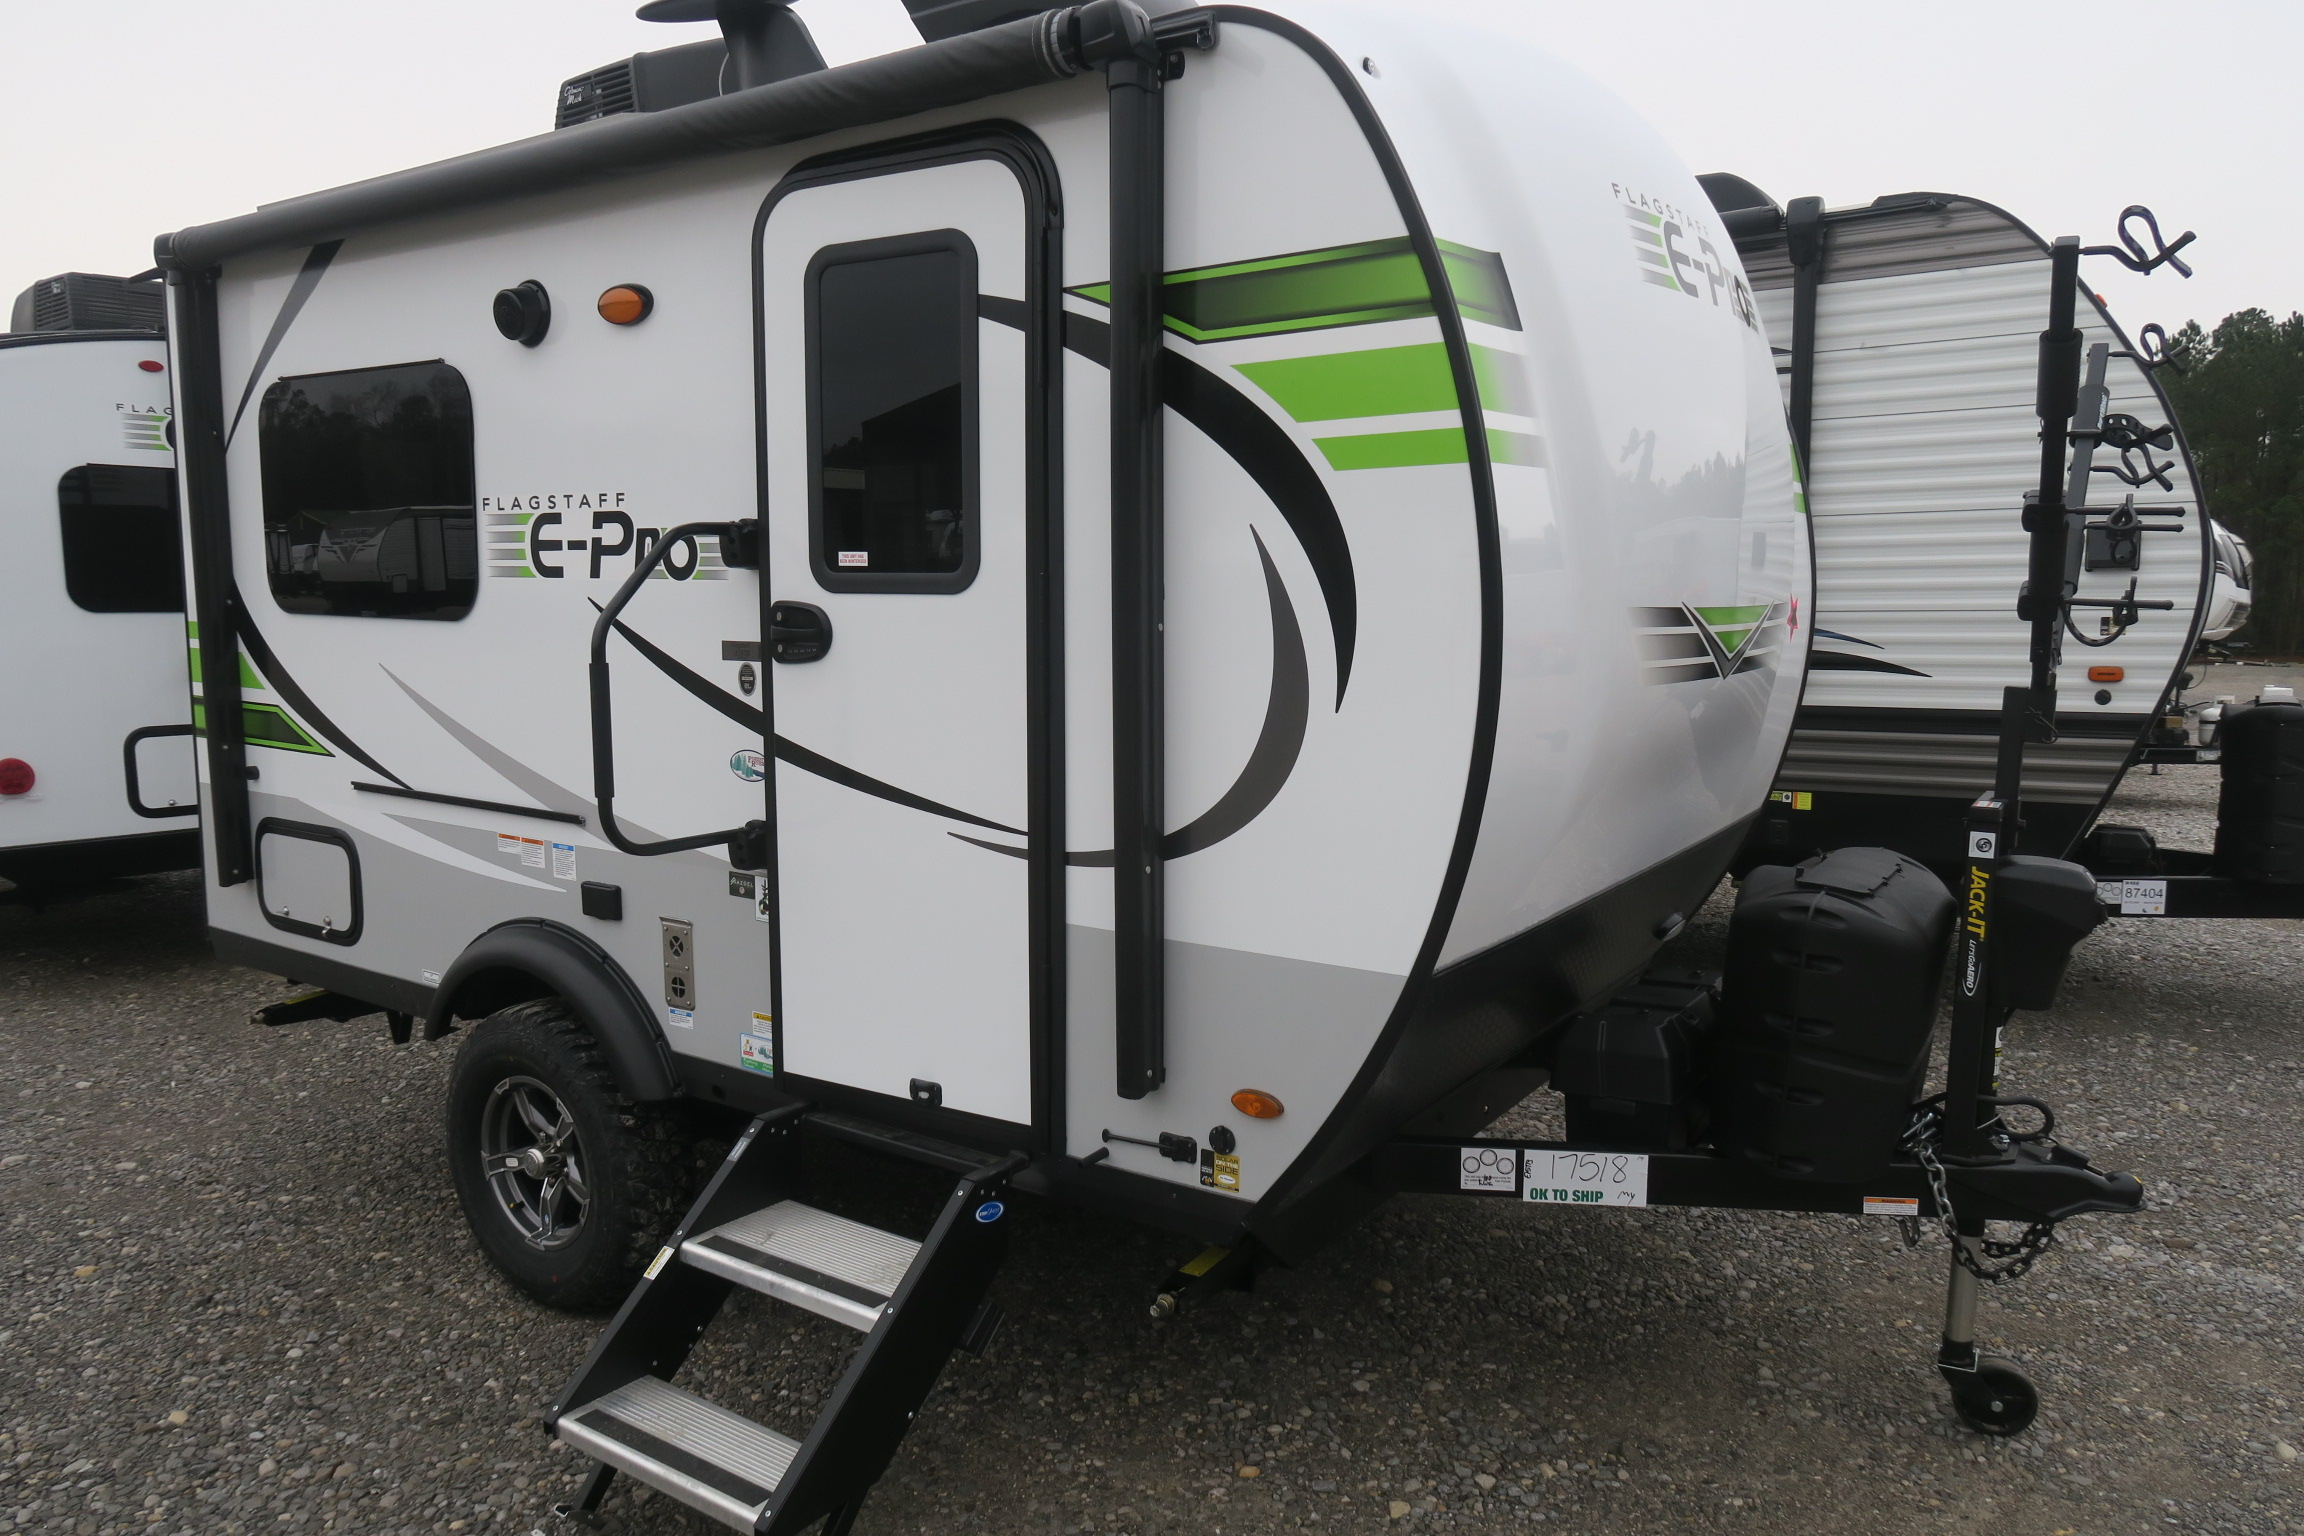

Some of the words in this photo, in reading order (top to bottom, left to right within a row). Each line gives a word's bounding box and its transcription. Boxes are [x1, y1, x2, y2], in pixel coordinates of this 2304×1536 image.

[1610, 182, 1710, 238] FLAGSTAFF
[482, 492, 625, 511] FLAGSTAFF
[2125, 887, 2163, 899] 87404
[1966, 865, 1990, 938] JACK-IT
[1216, 1155, 1239, 1165] SOLAR
[1216, 1164, 1239, 1175] SIDE
[1551, 1153, 1628, 1184] 17518
[1530, 1188, 1548, 1200] OK
[1552, 1188, 1568, 1201] TO
[1572, 1189, 1604, 1202] SHIP
